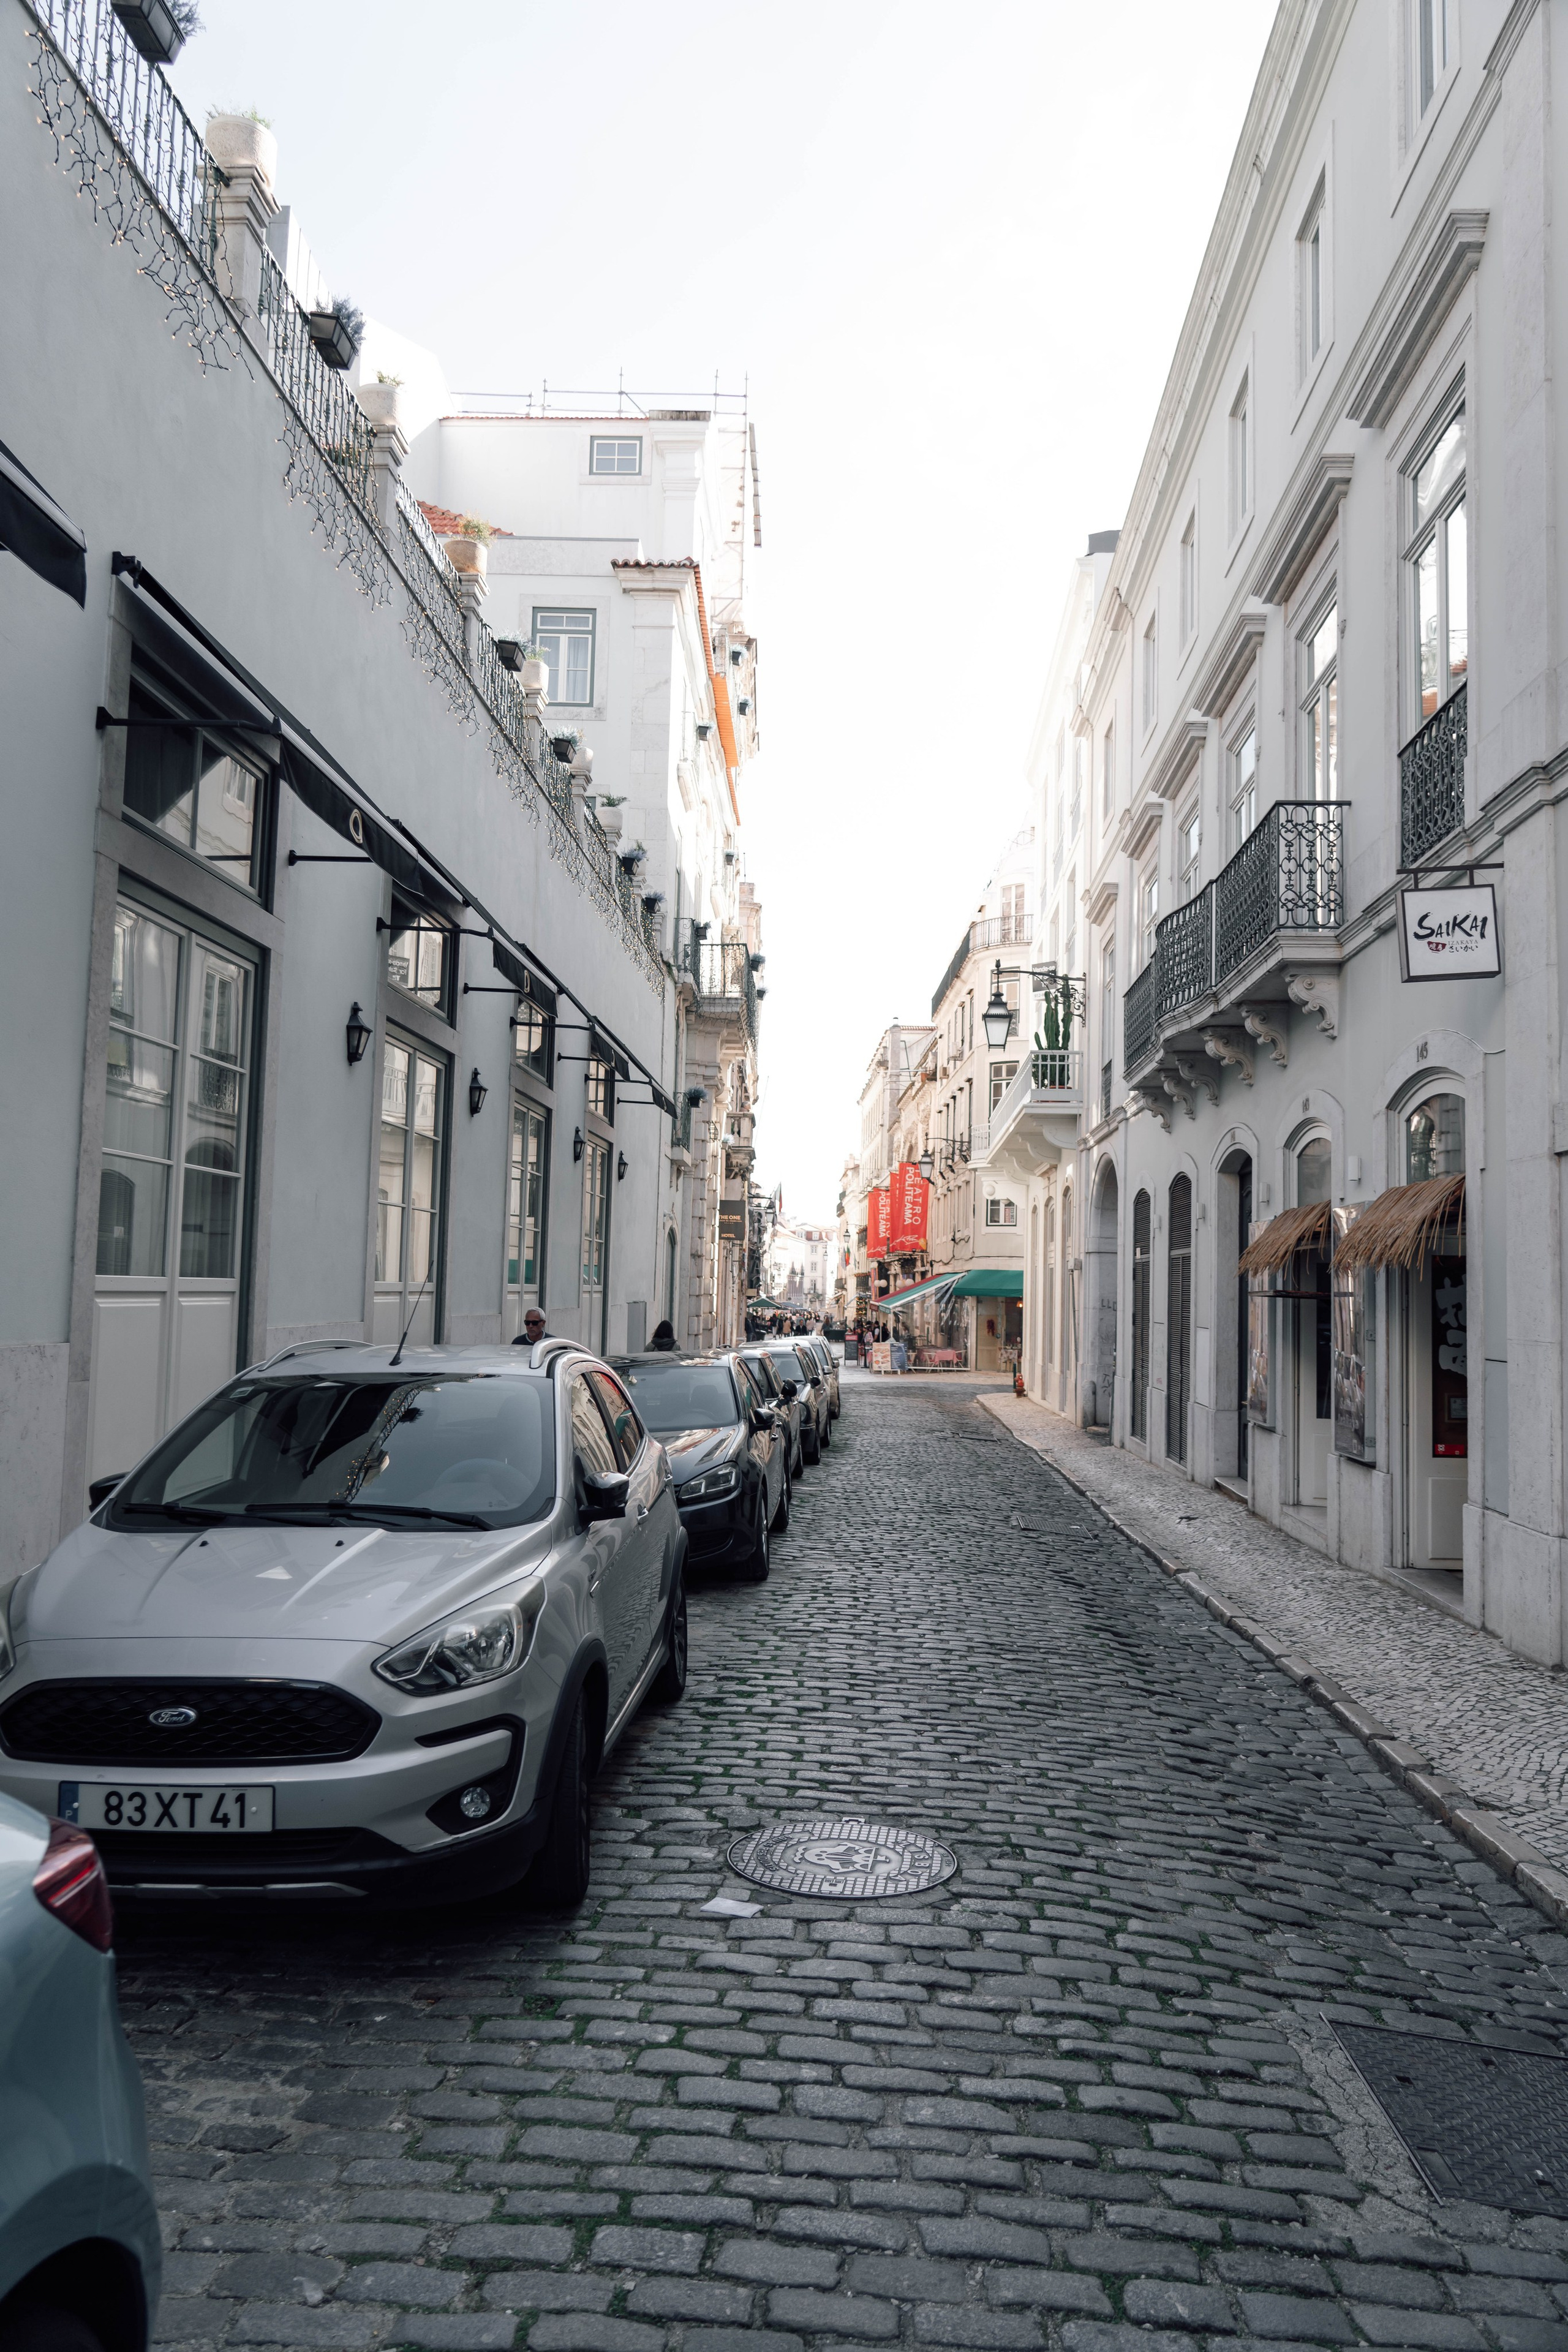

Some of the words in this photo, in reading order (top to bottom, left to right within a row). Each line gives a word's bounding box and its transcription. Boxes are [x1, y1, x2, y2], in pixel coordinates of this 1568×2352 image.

[1413, 911, 1488, 941] SAIKAI
[903, 1167, 914, 1225] POLITEAMA
[158, 1711, 186, 1723] Ford
[65, 1809, 73, 1819] P
[890, 1840, 930, 1881] LISBOA
